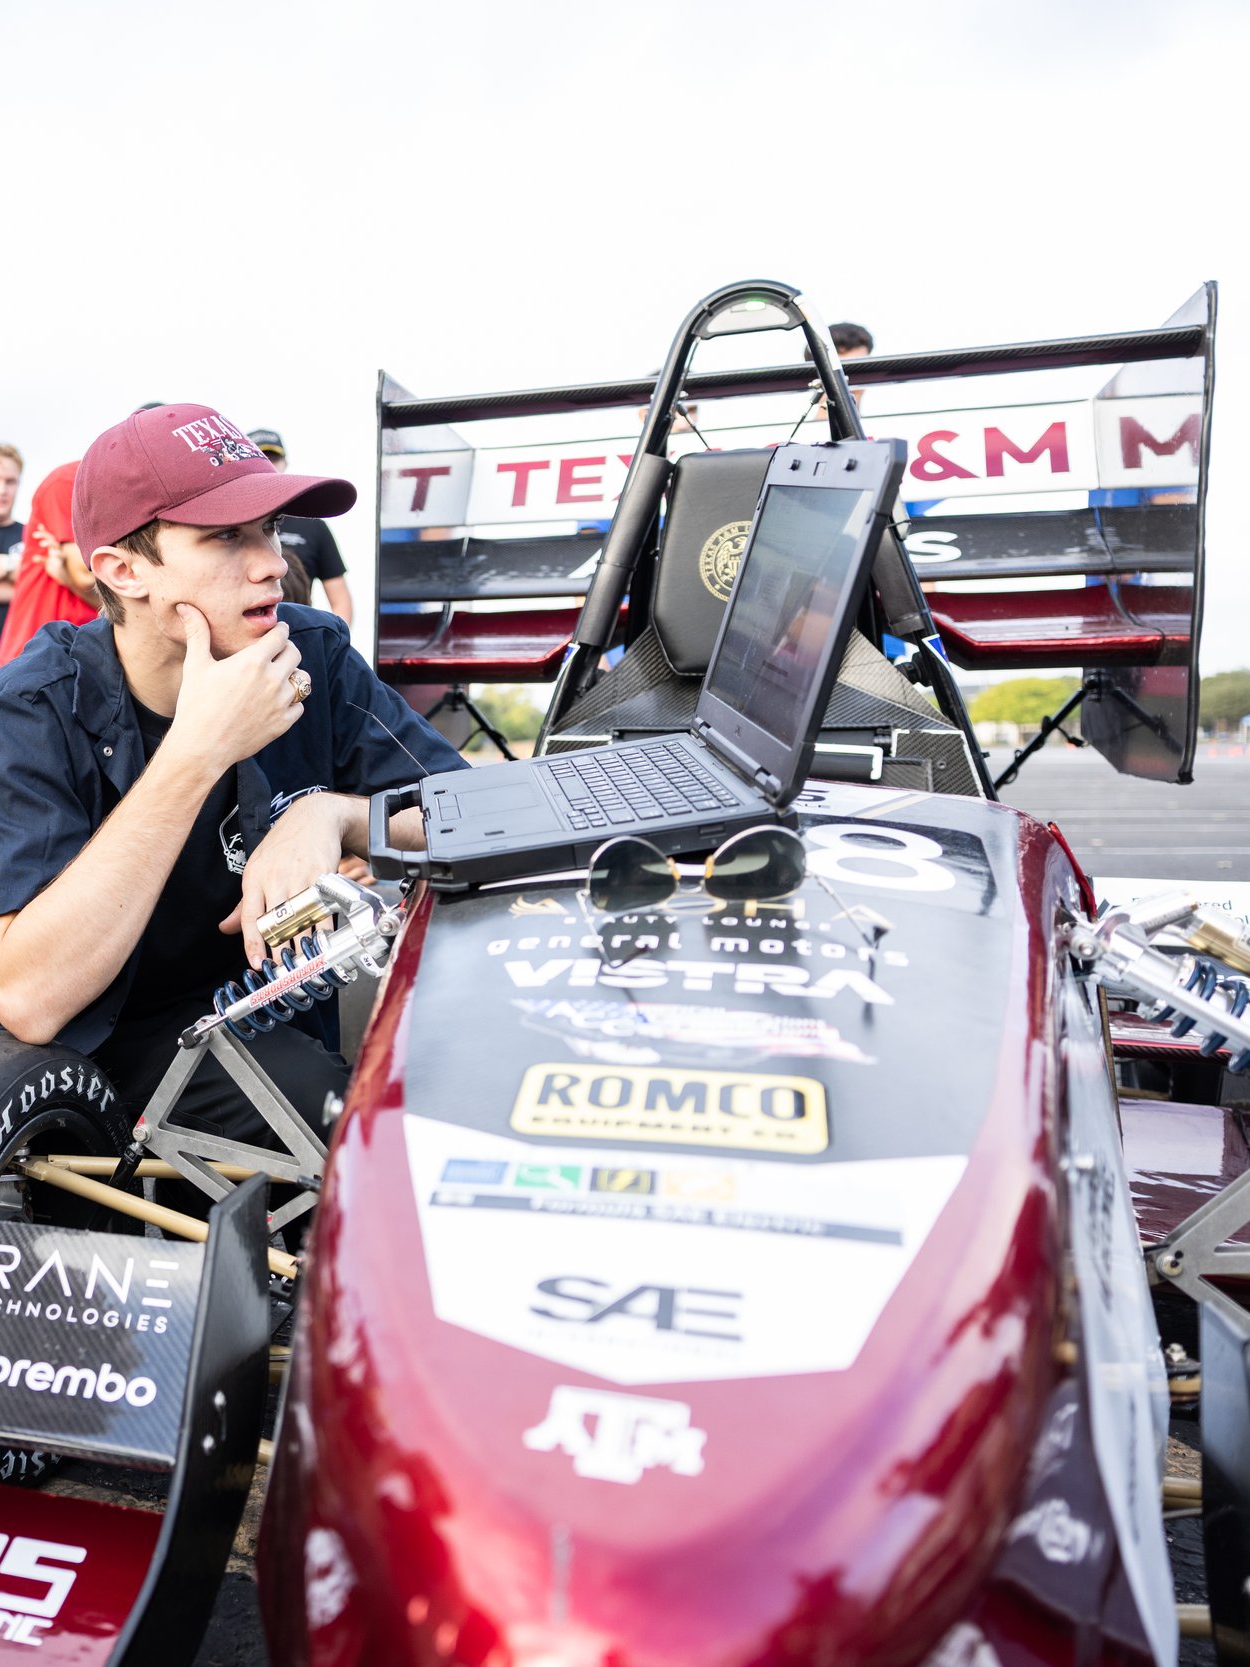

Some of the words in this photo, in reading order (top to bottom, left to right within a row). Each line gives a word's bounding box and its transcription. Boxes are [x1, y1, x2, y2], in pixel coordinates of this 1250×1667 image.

[171, 414, 243, 453] TEXAS
[909, 421, 1071, 483] &M
[486, 934, 683, 956] general
[710, 936, 910, 967] motors
[503, 957, 896, 1006] VISTRA
[536, 1072, 807, 1122] ROMCO
[528, 1275, 744, 1343] SAE
